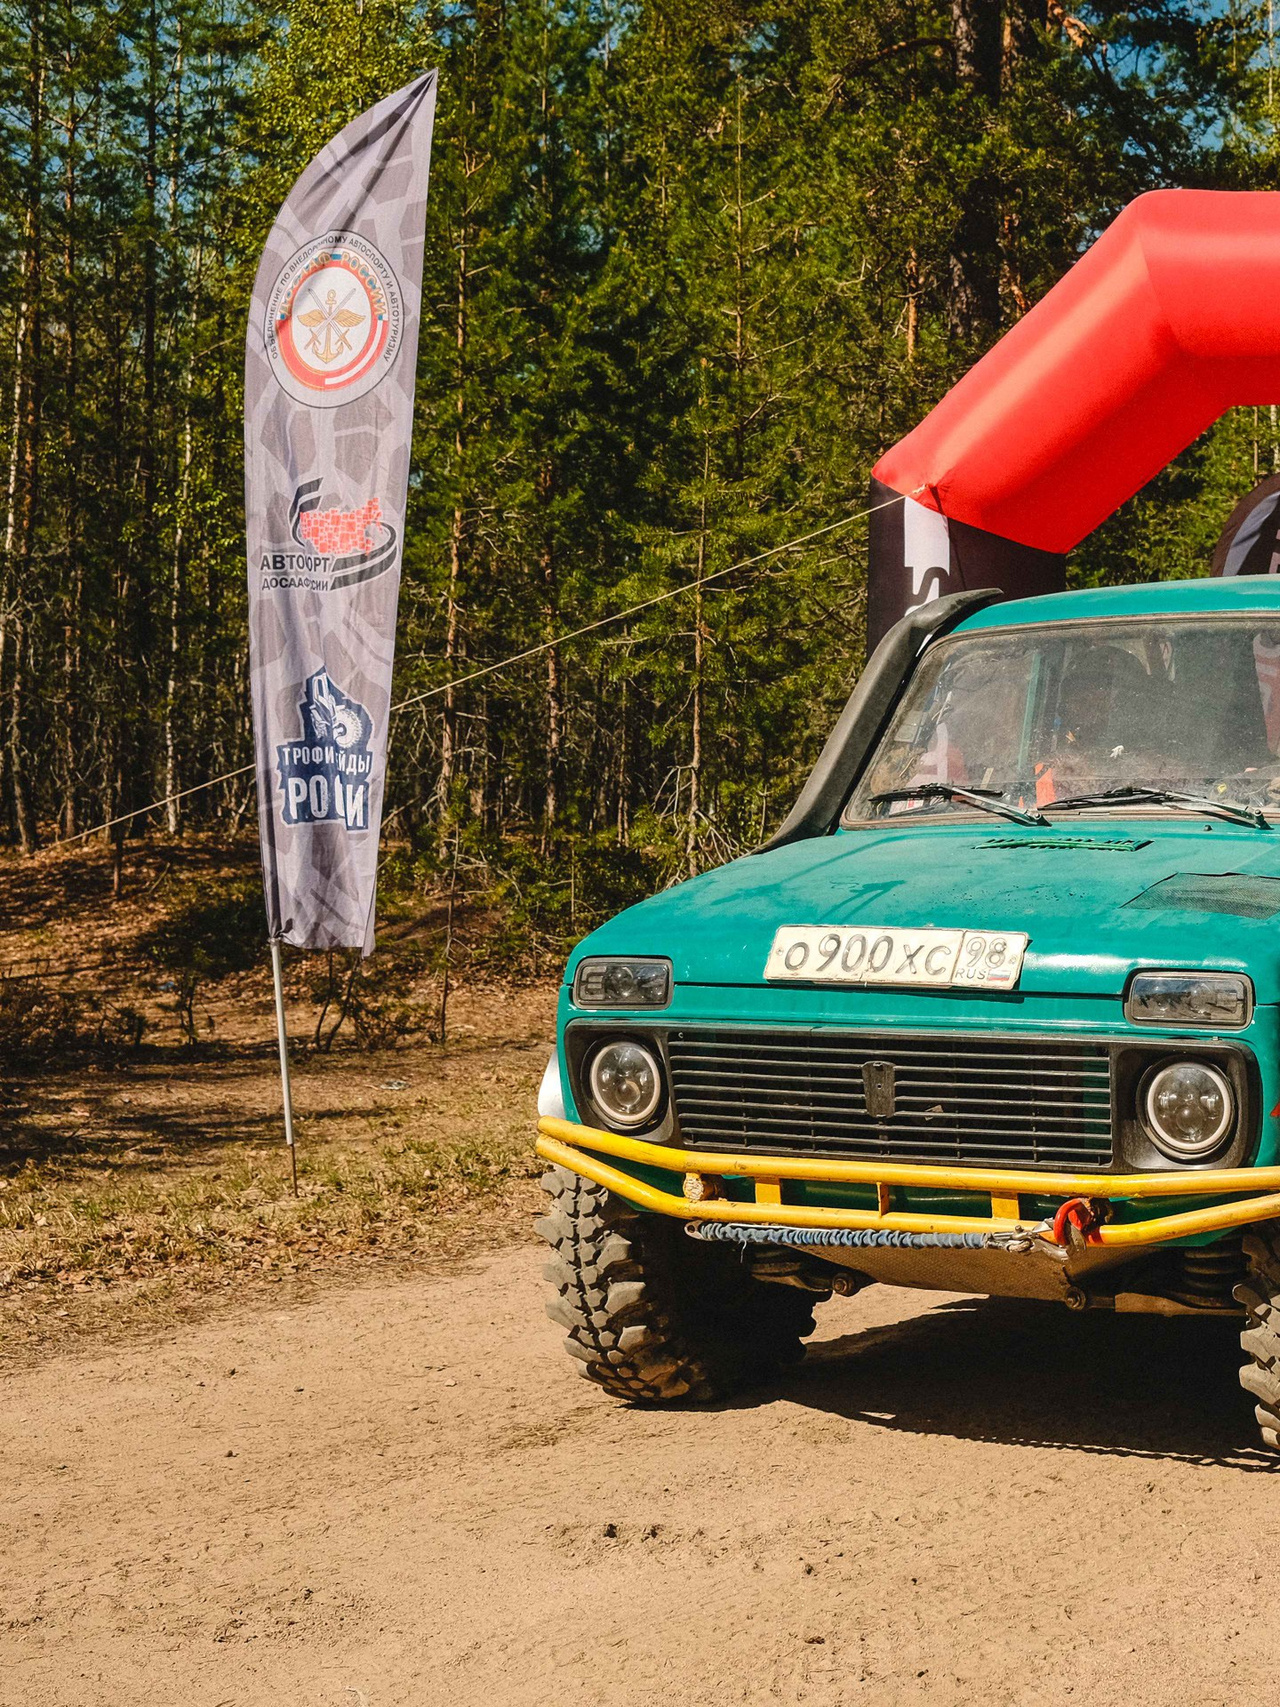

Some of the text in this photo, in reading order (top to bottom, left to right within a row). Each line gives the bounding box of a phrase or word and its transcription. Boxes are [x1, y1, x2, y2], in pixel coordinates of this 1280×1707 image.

[281, 272, 291, 287] ПО
[348, 237, 391, 284] АВТОСПОРТУ
[382, 289, 400, 363] АВТОТУРИЗМУ
[340, 251, 387, 315] РОССИИ
[283, 746, 335, 766] ТРОФИ
[966, 936, 1008, 970] 98
[955, 967, 987, 981] RUS
